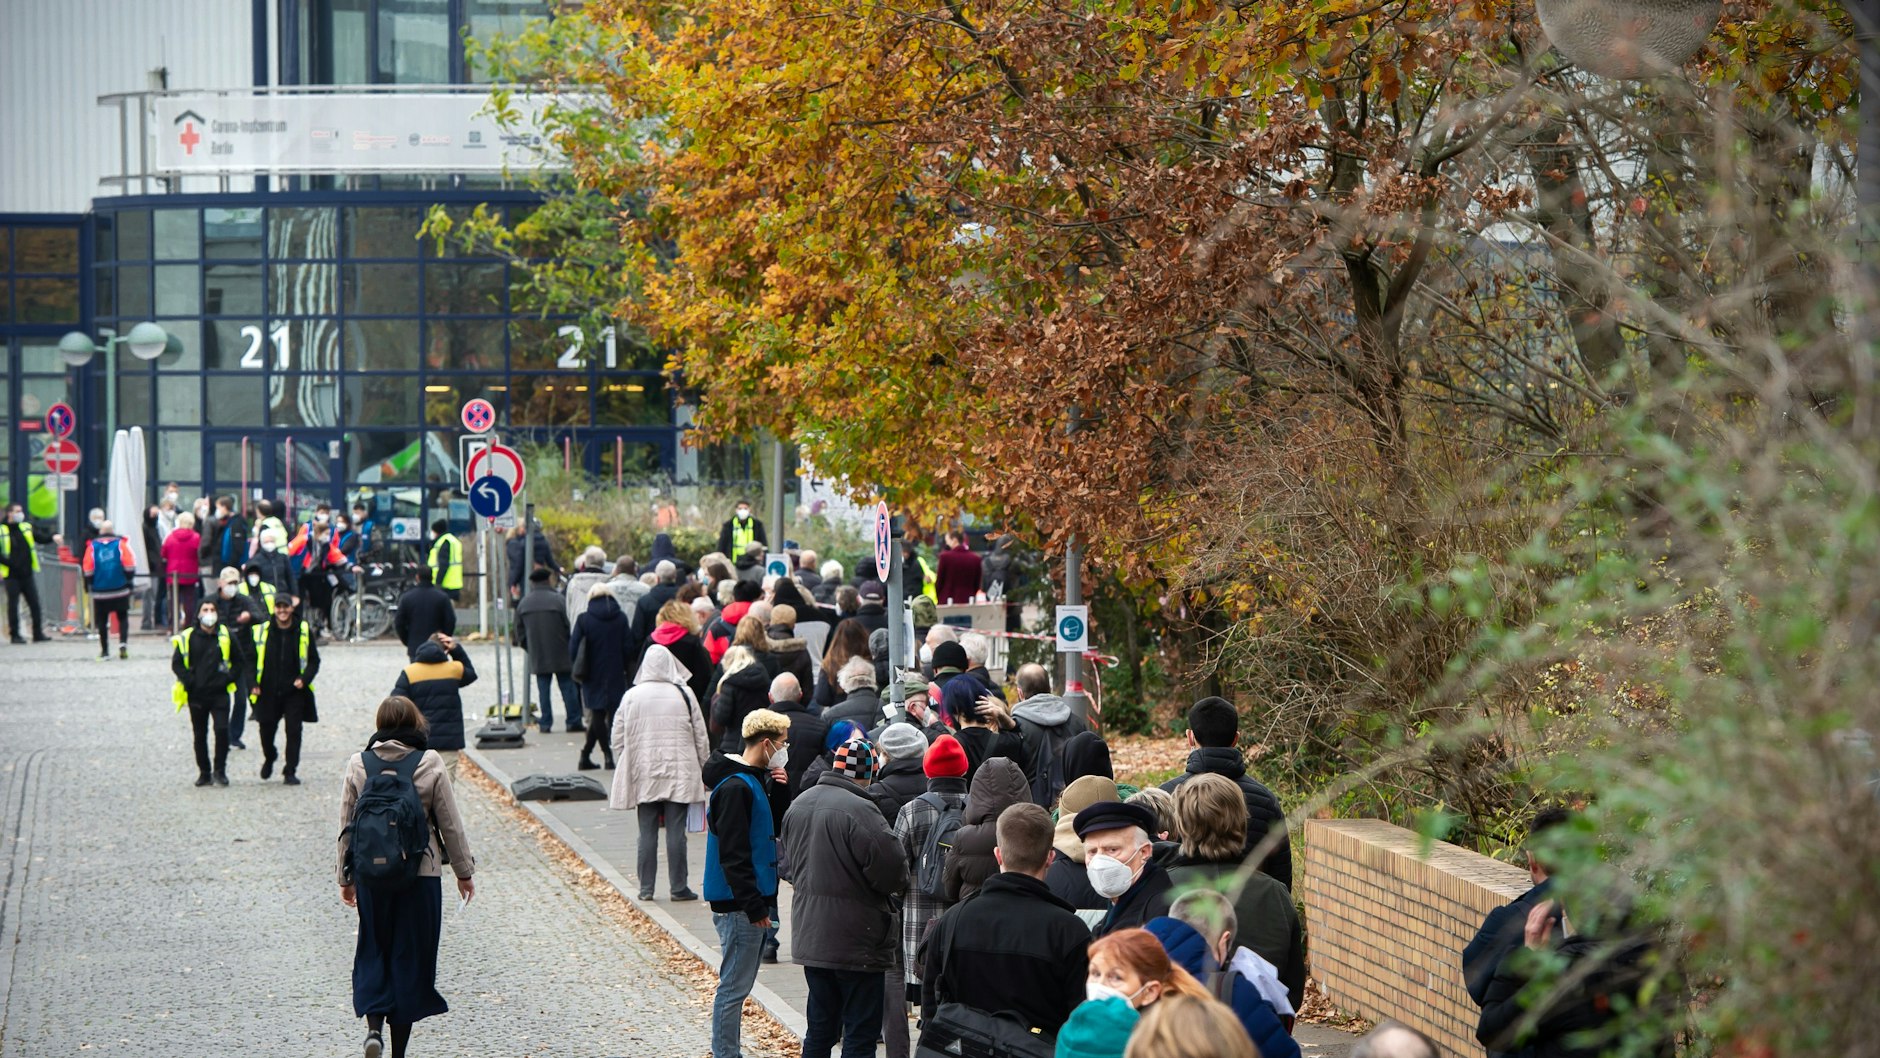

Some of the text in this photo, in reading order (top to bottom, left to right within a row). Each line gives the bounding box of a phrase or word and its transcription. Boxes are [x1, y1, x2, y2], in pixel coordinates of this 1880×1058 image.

[211, 141, 233, 154] Berlin
[241, 325, 289, 368] 21
[557, 325, 616, 368] 21
